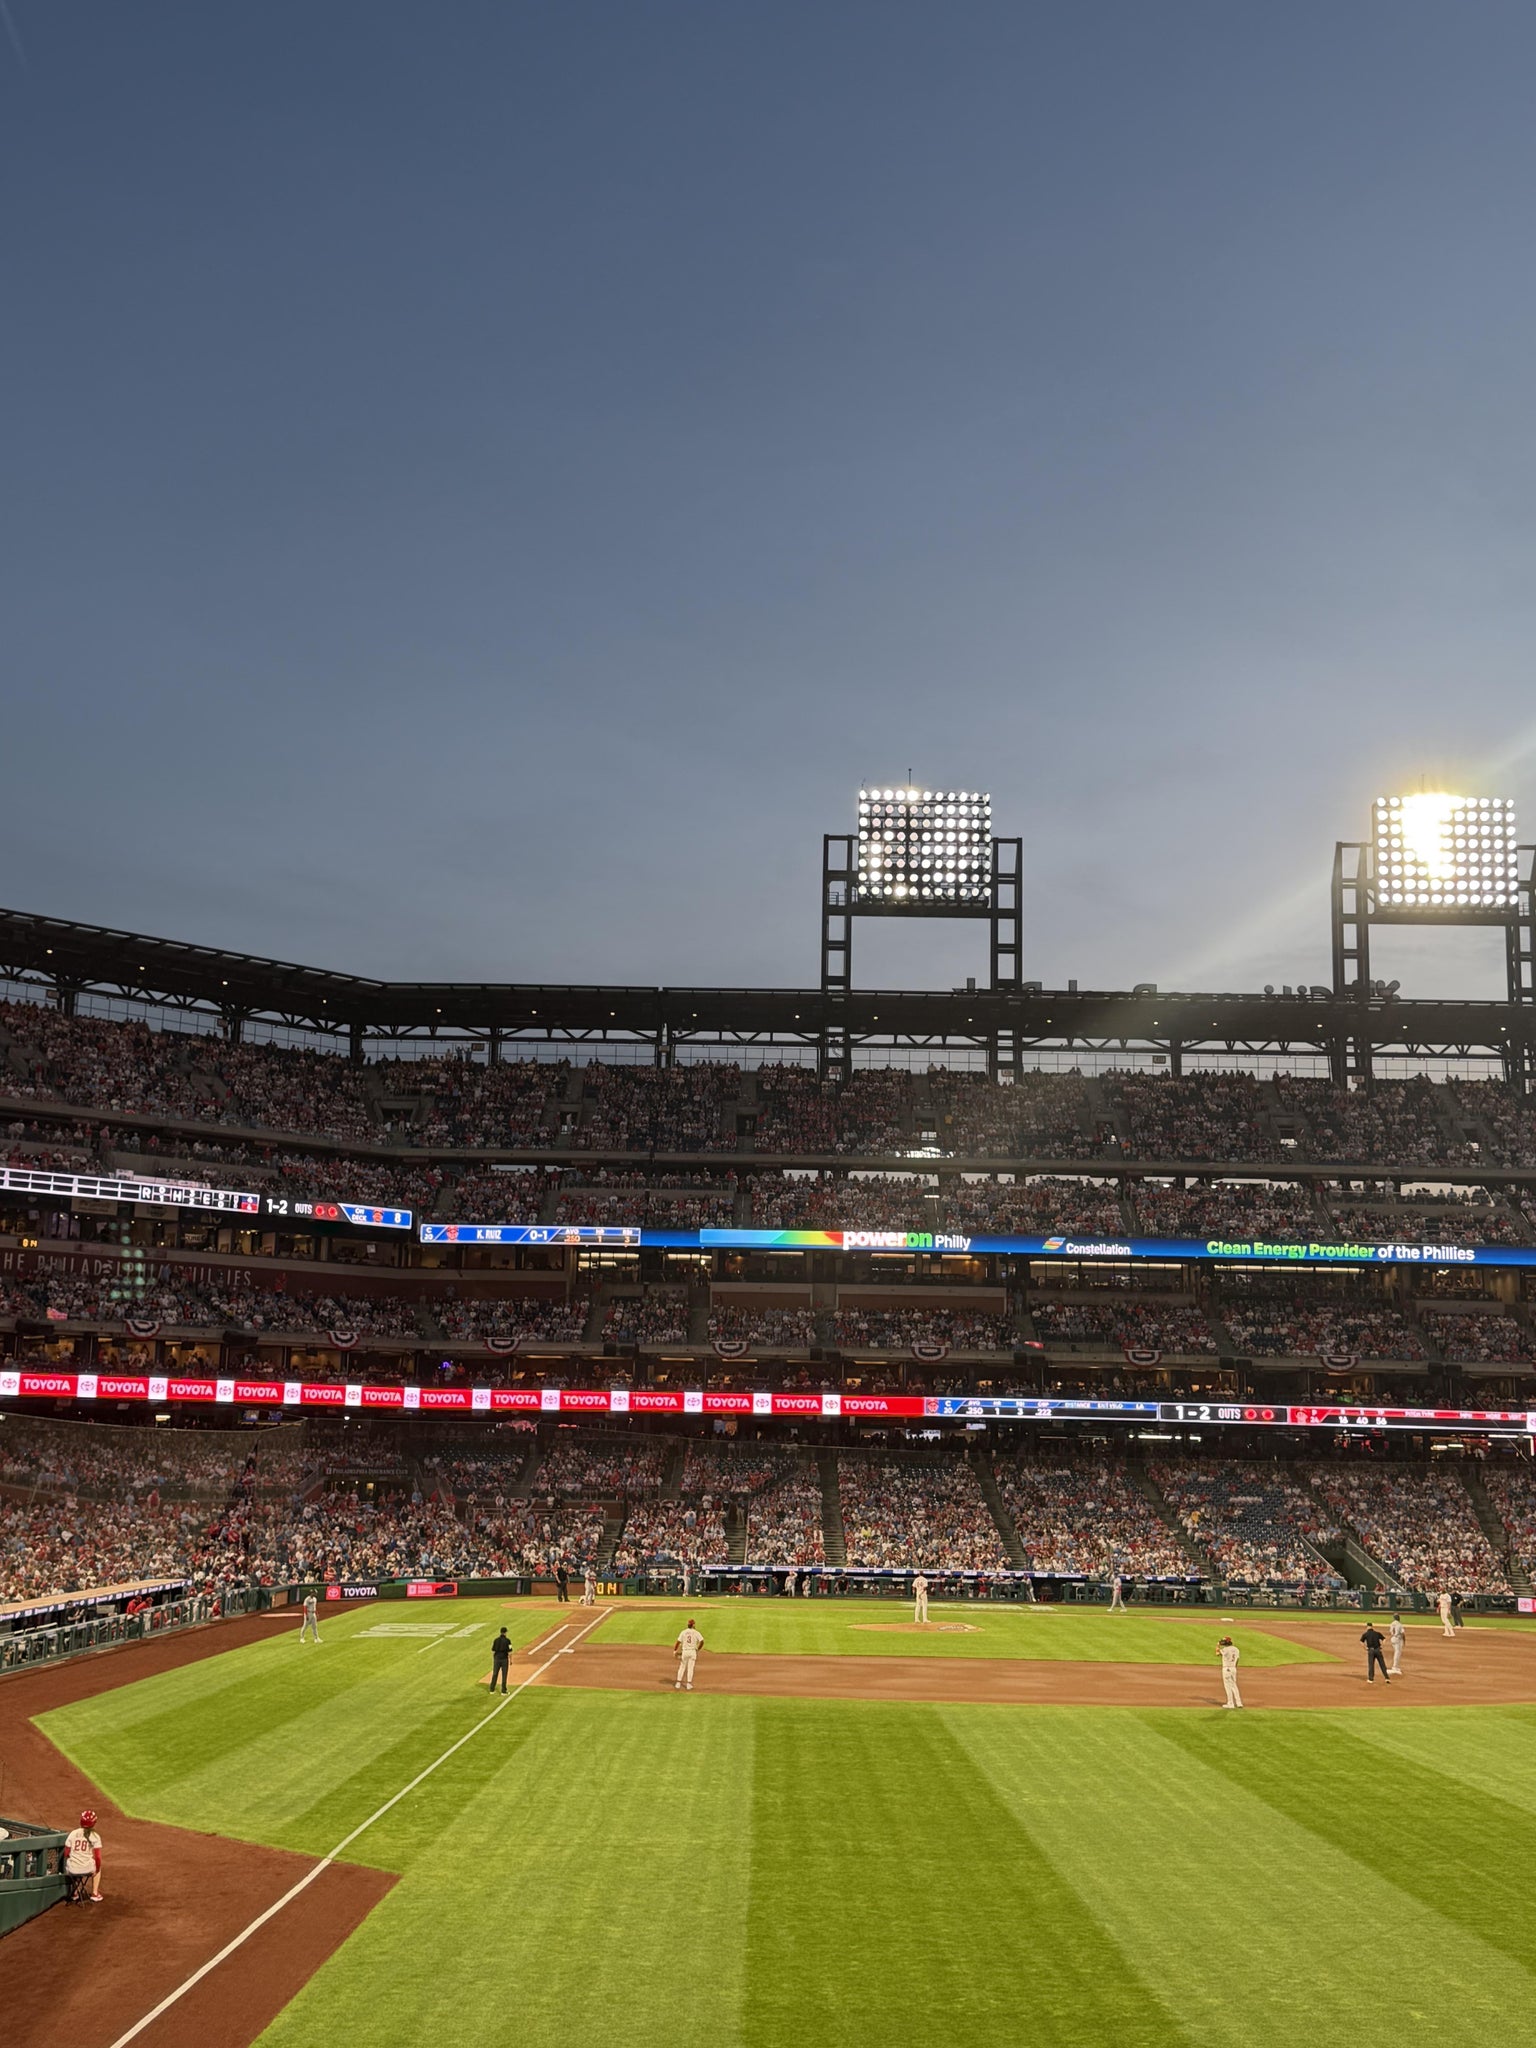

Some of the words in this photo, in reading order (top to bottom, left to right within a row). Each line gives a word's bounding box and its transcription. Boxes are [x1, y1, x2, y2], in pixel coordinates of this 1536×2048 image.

[142, 1187, 151, 1199] R
[172, 1190, 182, 1202] H
[202, 1193, 210, 1205] E
[266, 1198, 288, 1214] 1-2
[294, 1202, 312, 1214] OUTS
[530, 1230, 548, 1240] 0-1
[842, 1230, 932, 1250] poweron
[934, 1234, 971, 1250] Philly
[1066, 1242, 1131, 1254] Constellation
[1206, 1240, 1250, 1256] Clean
[1254, 1242, 1306, 1260] Energy
[1310, 1242, 1374, 1258] Provider
[1377, 1245, 1394, 1258] of
[1394, 1245, 1420, 1259] the
[1423, 1246, 1475, 1261] Phillies
[37, 1255, 169, 1283] PHILADLPHI
[23, 1378, 70, 1392] TOYOTA
[100, 1380, 146, 1393] TOYOTA
[170, 1383, 214, 1395] TOYOTA
[237, 1386, 278, 1398] TOYOTA
[303, 1388, 343, 1400] TOYOTA
[364, 1391, 402, 1402] TOYOTA
[422, 1393, 466, 1404] TOYOTA
[494, 1394, 538, 1405] TOYOTA
[563, 1395, 607, 1406] TOYOTA
[633, 1396, 678, 1407] TOYOTA
[706, 1396, 750, 1408] TOYOTA
[775, 1398, 819, 1409] TOYOTA
[844, 1400, 888, 1410] TOYOTA
[1218, 1408, 1241, 1419] OUTS
[344, 1586, 377, 1597] TOYOTA
[687, 1635, 691, 1643] 3
[74, 1840, 88, 1851] 28
